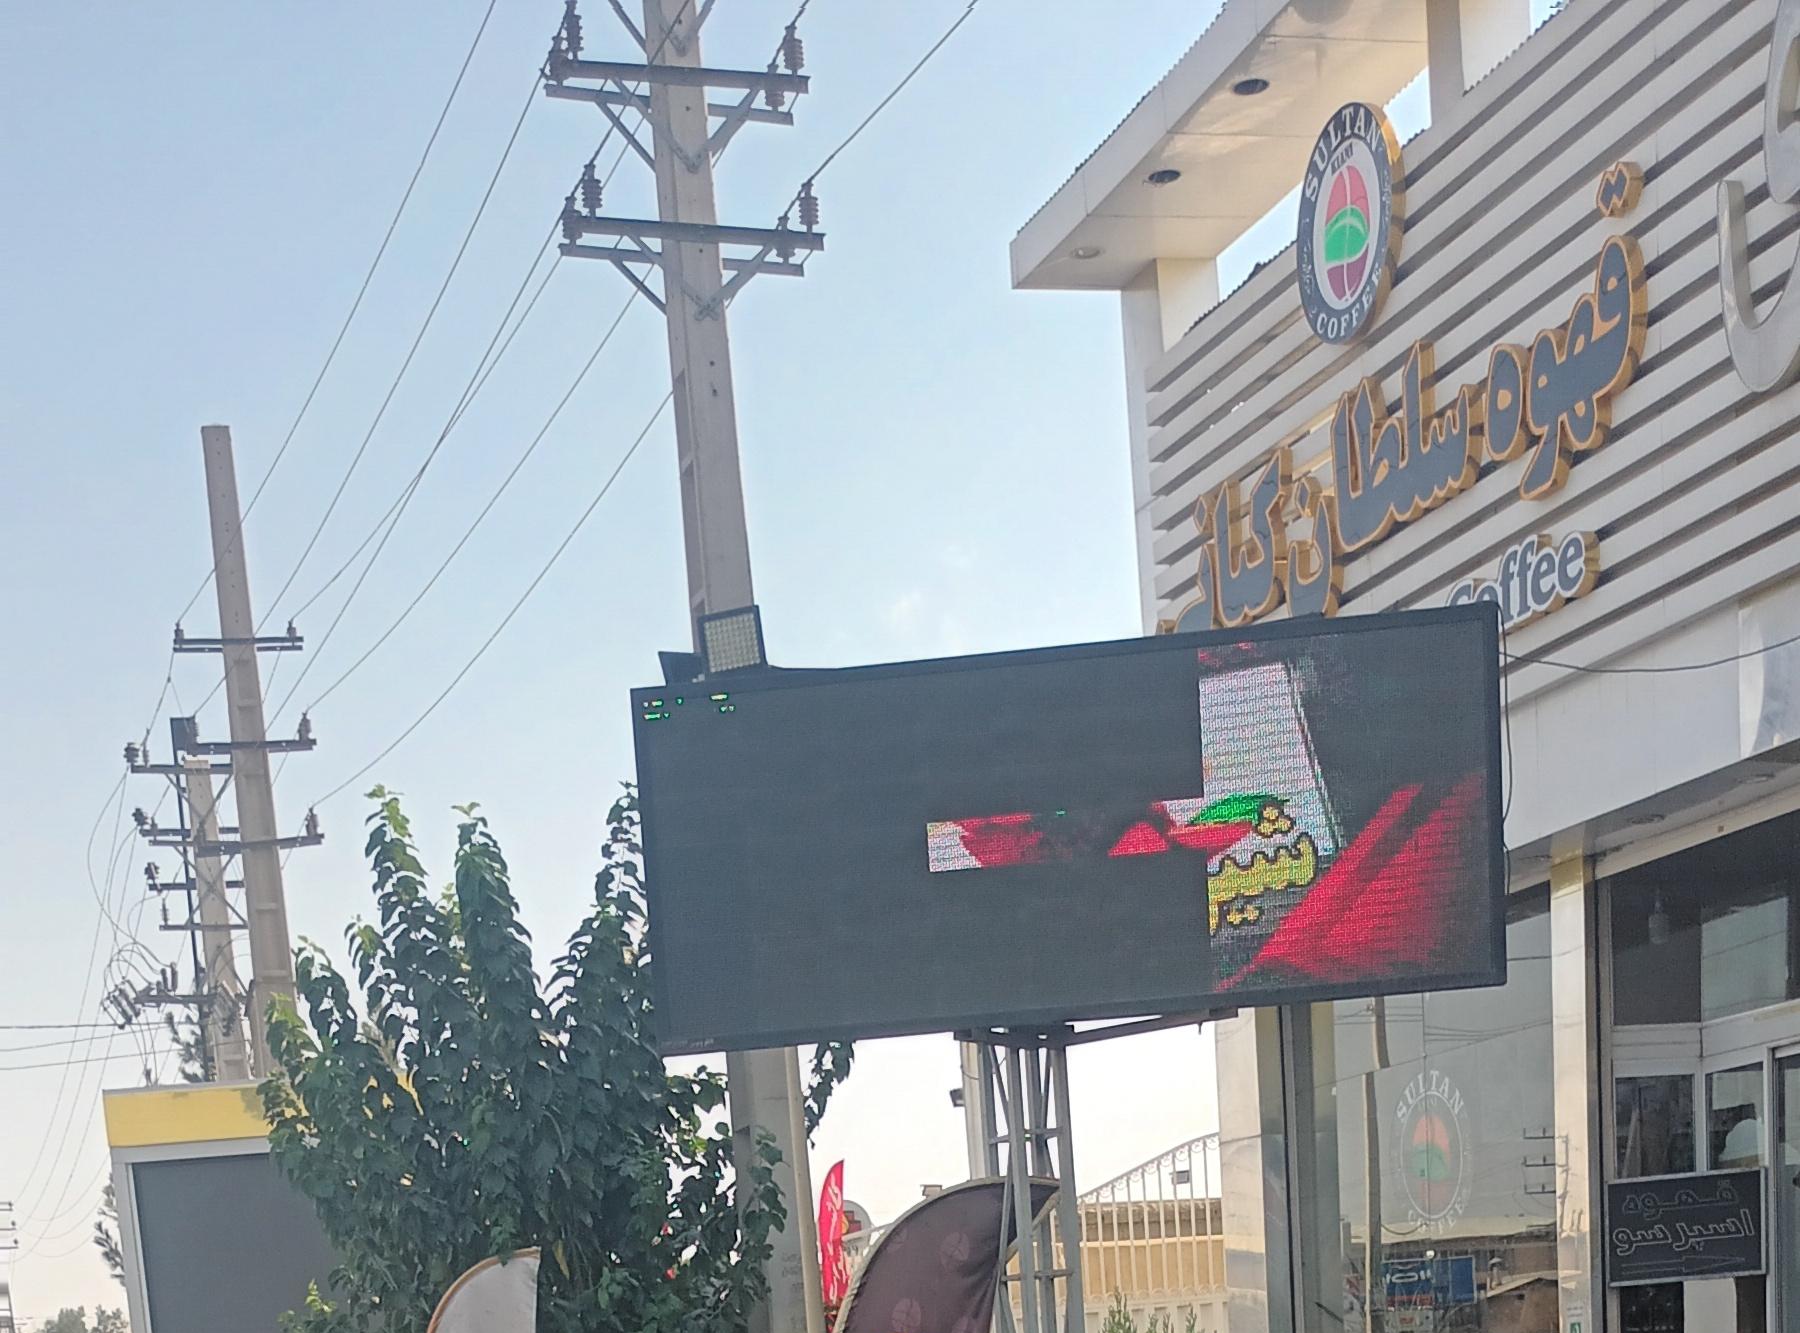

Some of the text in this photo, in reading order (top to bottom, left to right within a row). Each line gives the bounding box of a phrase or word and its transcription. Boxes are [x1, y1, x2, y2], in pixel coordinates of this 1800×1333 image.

[1305, 106, 1382, 202] SULTAN
[1317, 262, 1382, 339] COFFEE
[1484, 161, 1638, 501] قهوه
[1287, 340, 1475, 617] سلطان
[1397, 1069, 1464, 1122] SULTAN
[1612, 1208, 1755, 1256] اسپرسو
[1622, 1180, 1738, 1220] قهوه
